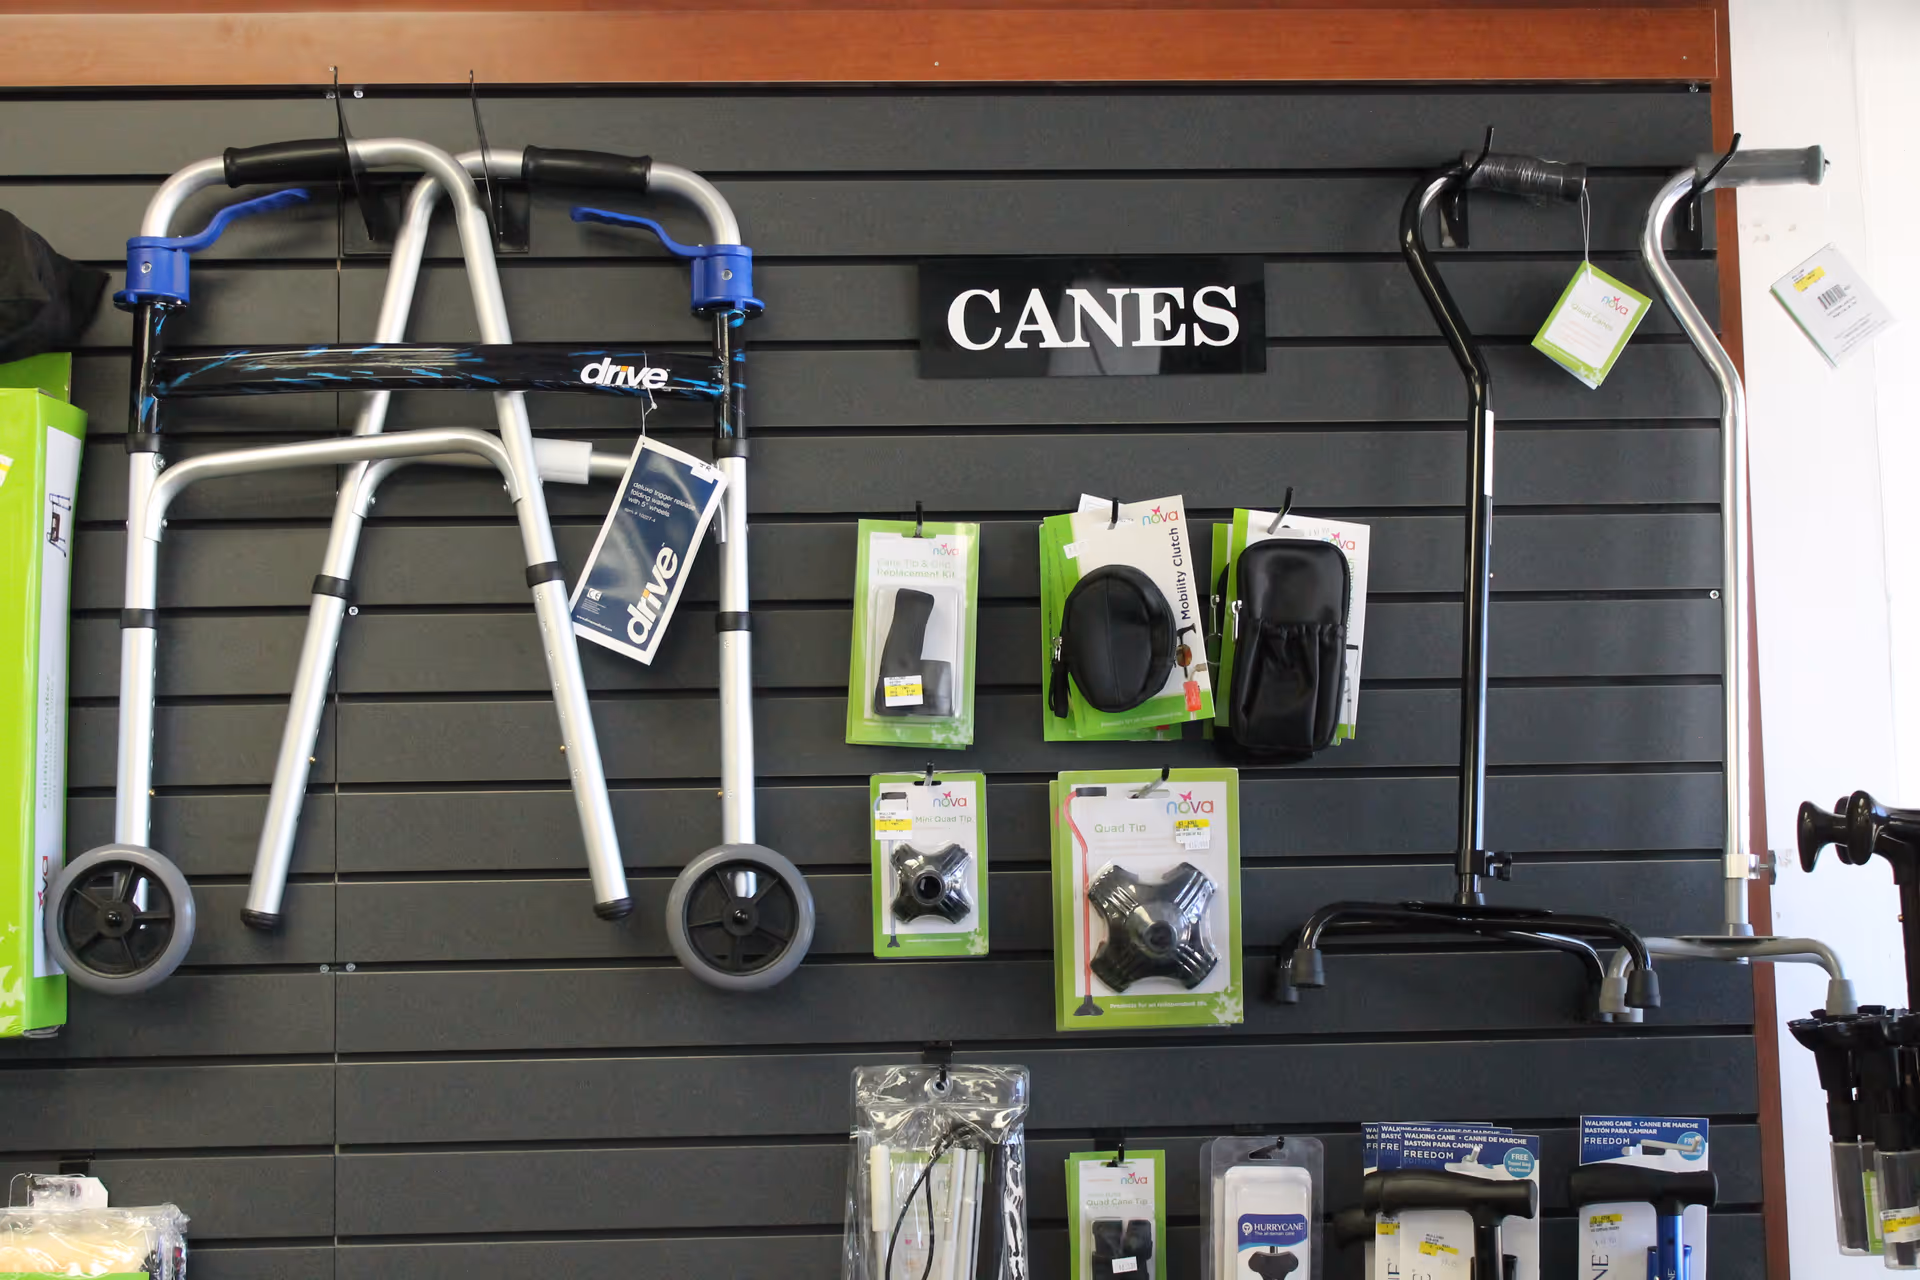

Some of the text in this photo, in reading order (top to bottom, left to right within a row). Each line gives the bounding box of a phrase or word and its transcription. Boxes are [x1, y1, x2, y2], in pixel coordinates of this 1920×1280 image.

[1601, 295, 1629, 316] nova
[947, 285, 1240, 350] CANES
[580, 357, 668, 389] drive
[631, 488, 672, 509] folding walker
[633, 482, 696, 511] deluxe trigger release
[628, 496, 641, 506] with
[649, 505, 670, 517] wheels
[1142, 510, 1179, 526] nova
[933, 547, 960, 556] nova
[877, 569, 940, 579] Replacement
[1168, 527, 1191, 620] Mobility Clutch
[626, 547, 679, 645] drive
[933, 797, 967, 807] nova
[1166, 800, 1214, 814] nova
[915, 815, 972, 823] Mini Quad Tip
[1094, 823, 1146, 833] Quad Tip
[1585, 1126, 1610, 1134] BASTÓN
[1404, 1132, 1432, 1140] WALKING
[1434, 1133, 1456, 1141] CANE
[1499, 1137, 1527, 1145] MARCHE
[1404, 1139, 1431, 1147] BASTÓN
[1584, 1137, 1630, 1145] FREEDOM
[1404, 1150, 1454, 1160] FREEDOM
[1120, 1176, 1148, 1184] nova
[1254, 1223, 1304, 1231] HURRYCANE
